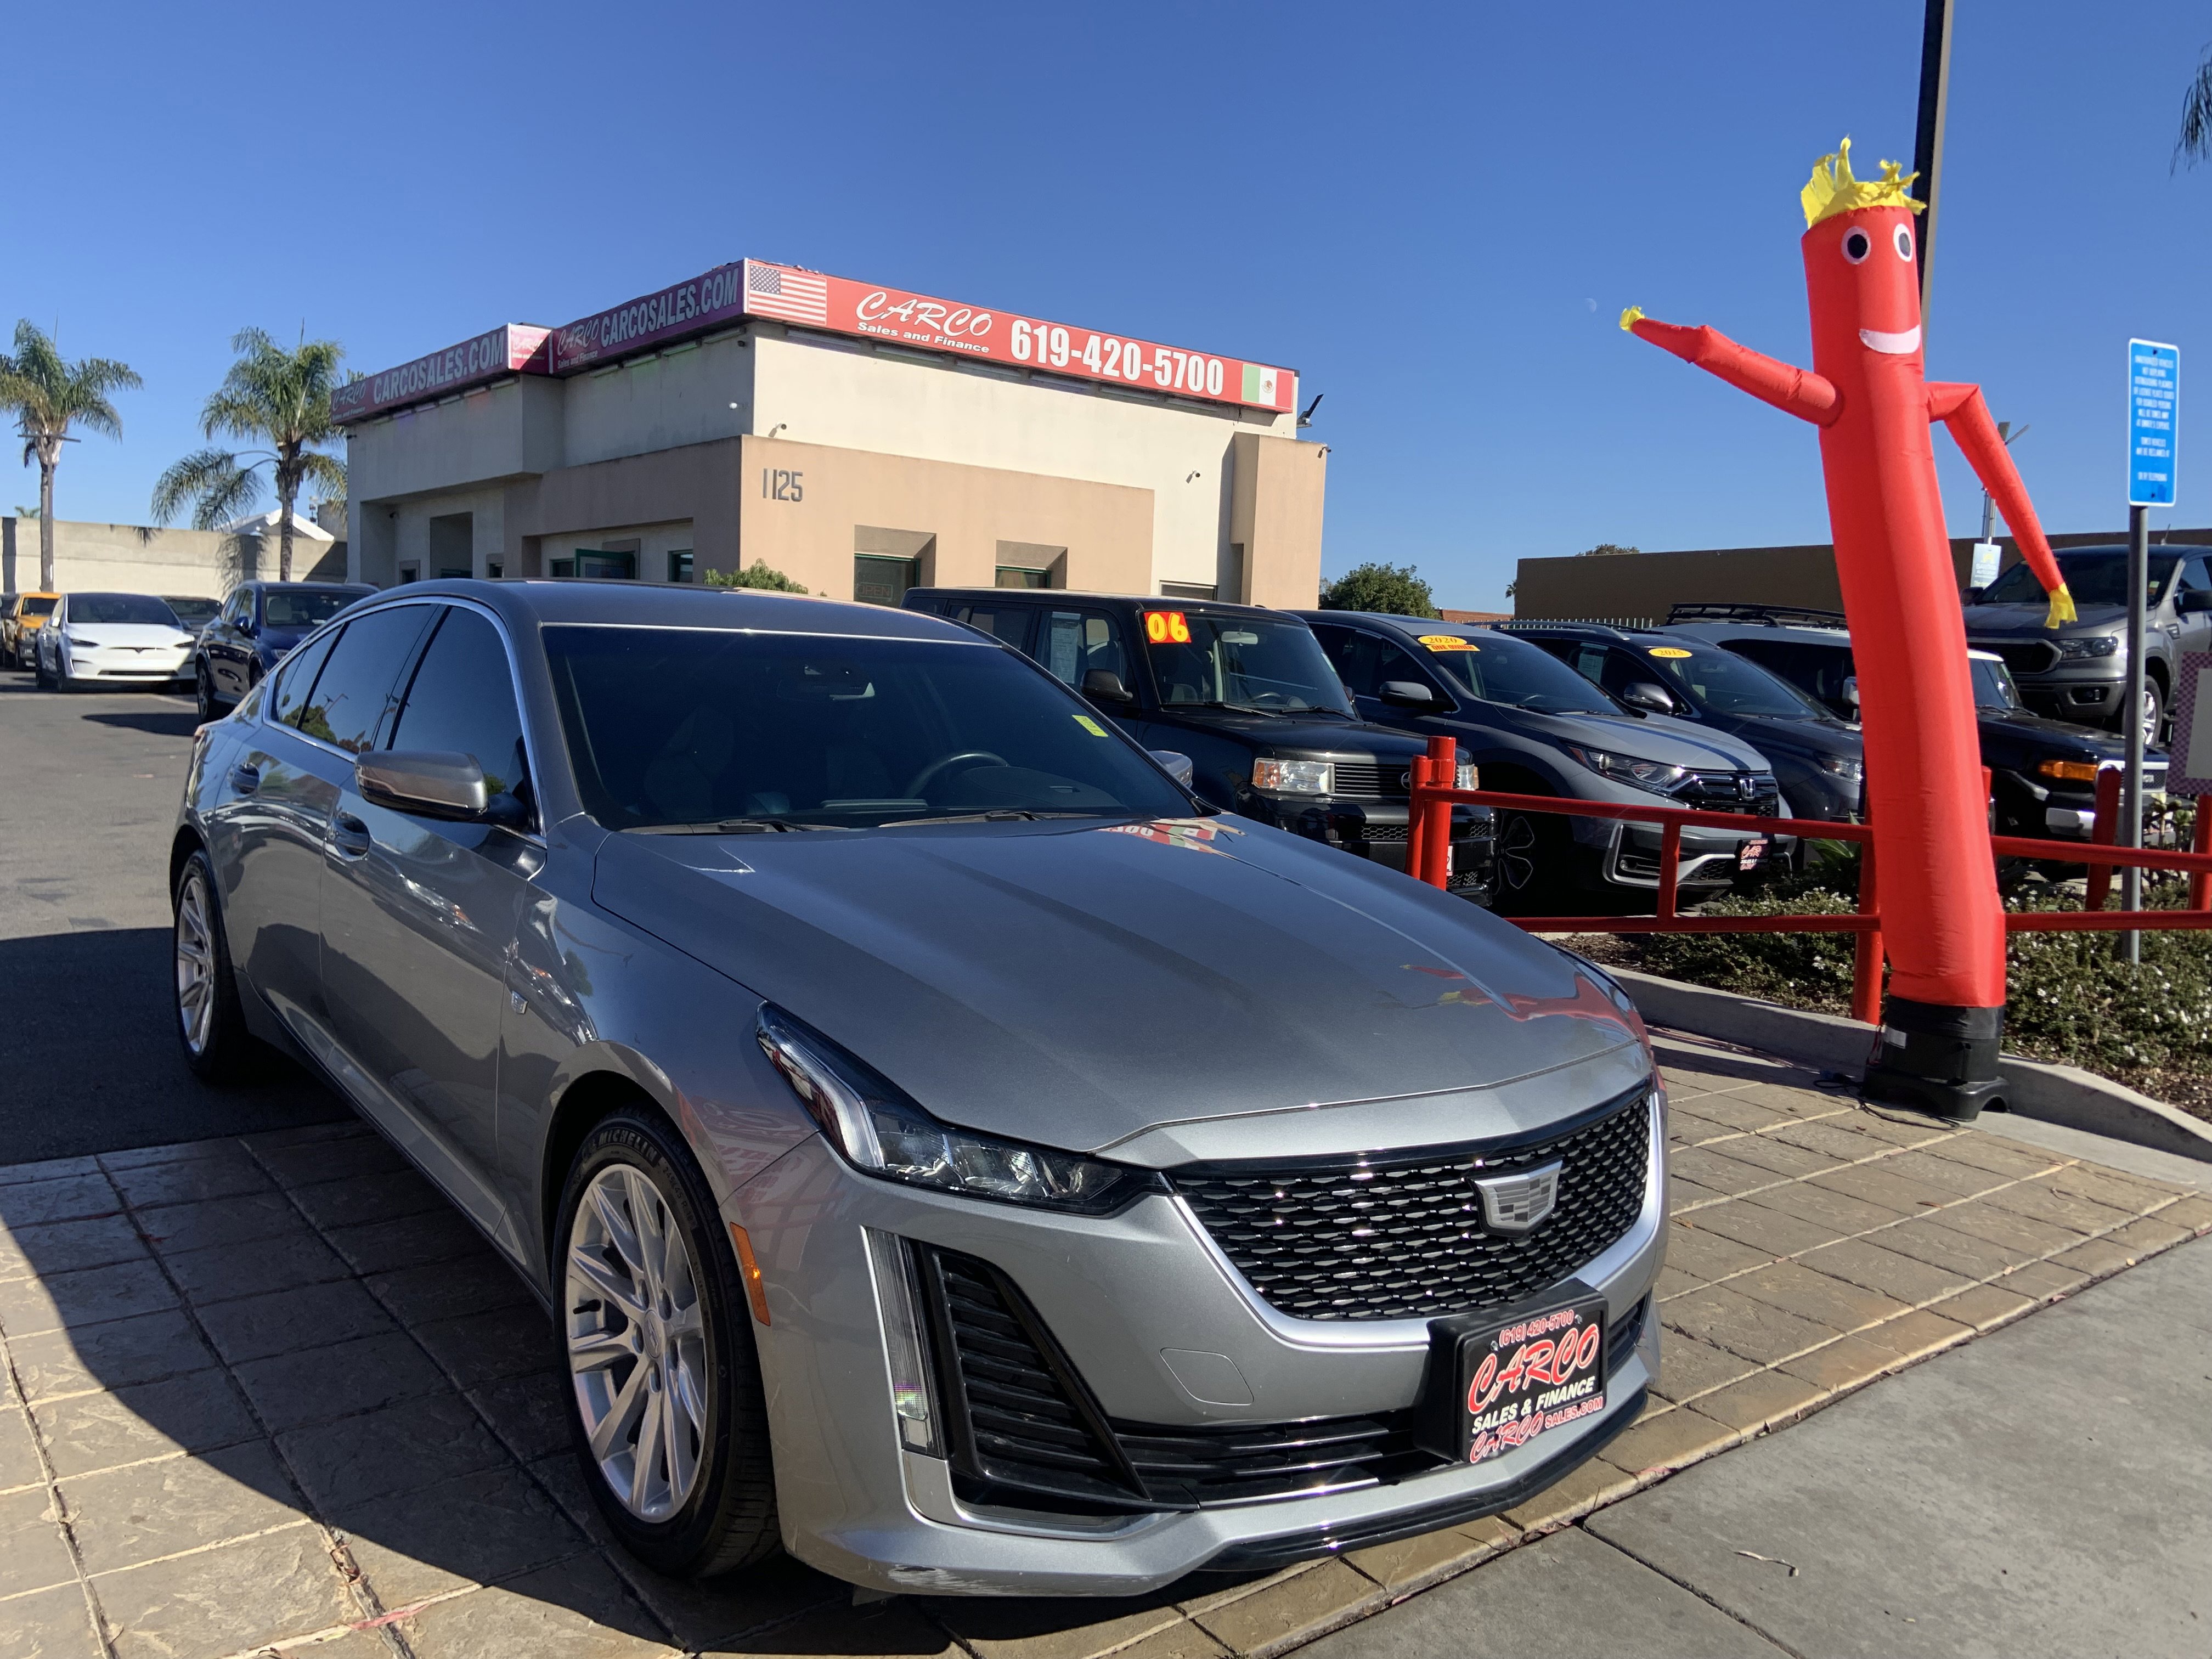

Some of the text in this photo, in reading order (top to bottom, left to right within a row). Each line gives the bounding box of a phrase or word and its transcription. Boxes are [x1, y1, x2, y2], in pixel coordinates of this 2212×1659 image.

[601, 267, 740, 348] CARCOSALES.COM
[856, 291, 992, 337] CARCO
[557, 318, 599, 356] CARCO
[857, 321, 990, 353] Sales and Finance
[374, 331, 505, 404] CARCOSALES.COM
[557, 359, 570, 369] Sales
[1011, 319, 1224, 396] 619-420-5700
[332, 381, 366, 412] CARCO
[763, 468, 803, 502] 1125
[857, 584, 890, 596] OPEN
[1148, 612, 1188, 642] 06
[599, 1128, 658, 1161] MICHELIN
[1499, 1309, 1575, 1348] (619) 420-5700
[1468, 1323, 1600, 1415] CARCO
[1472, 1375, 1595, 1434] SALES & FINANCE
[1470, 1396, 1604, 1464] CARCO SALES.COM
